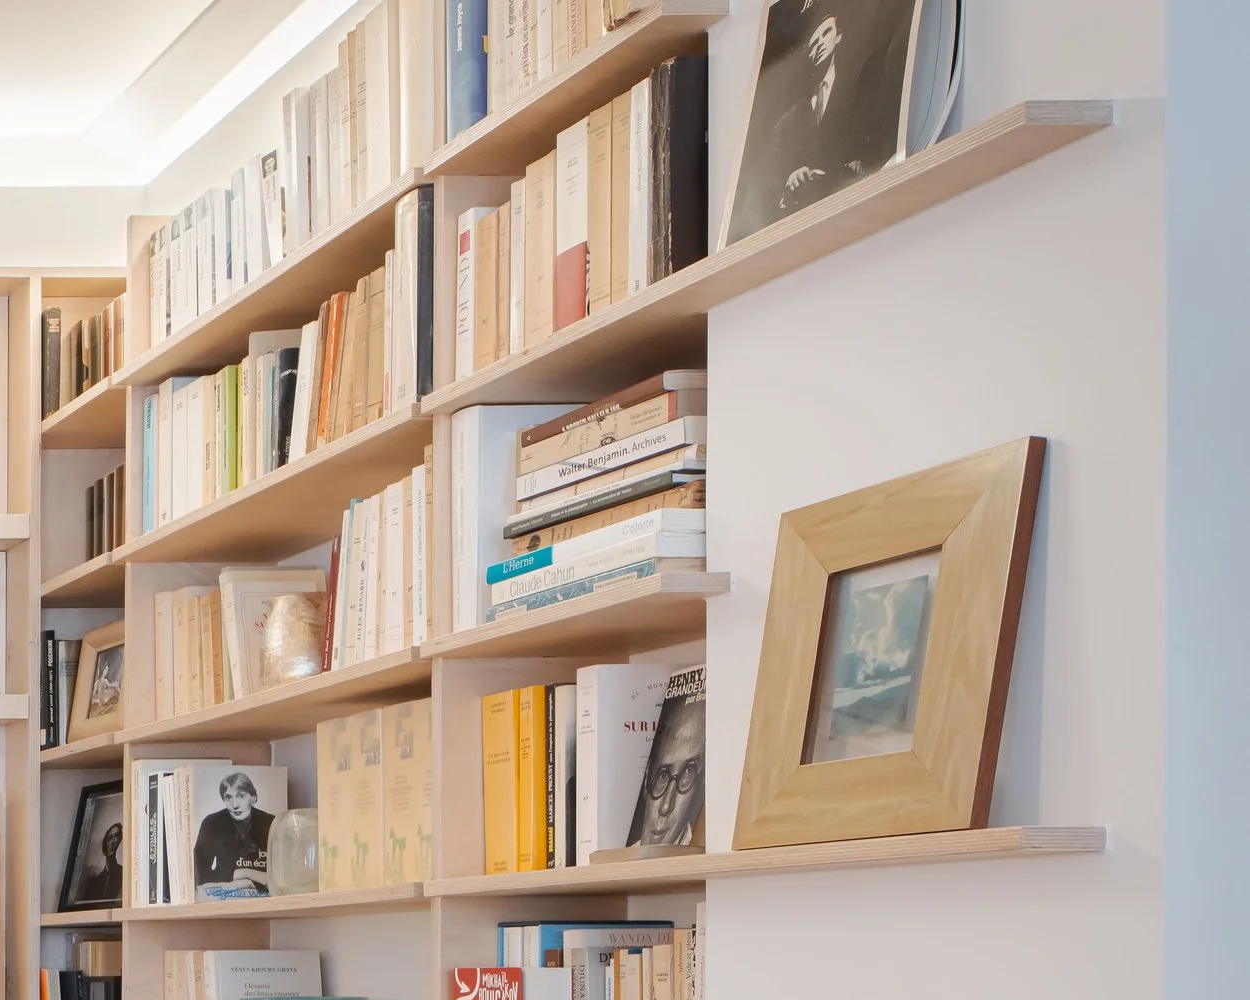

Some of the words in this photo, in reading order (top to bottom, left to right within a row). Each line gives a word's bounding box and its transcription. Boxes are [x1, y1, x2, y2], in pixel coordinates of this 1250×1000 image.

[558, 462, 586, 479] Walter
[587, 447, 631, 470] Benjamin.
[631, 433, 667, 452] Archives
[622, 517, 655, 536] Colette
[502, 555, 535, 575] L'Herne
[509, 575, 542, 598] Claude
[543, 564, 576, 586] Cahun
[668, 668, 703, 688] HENRY
[684, 697, 696, 707] par
[623, 720, 648, 732] SUR
[235, 856, 253, 867] d'un
[608, 931, 653, 944] WANDA
[578, 964, 587, 999] DJUNA
